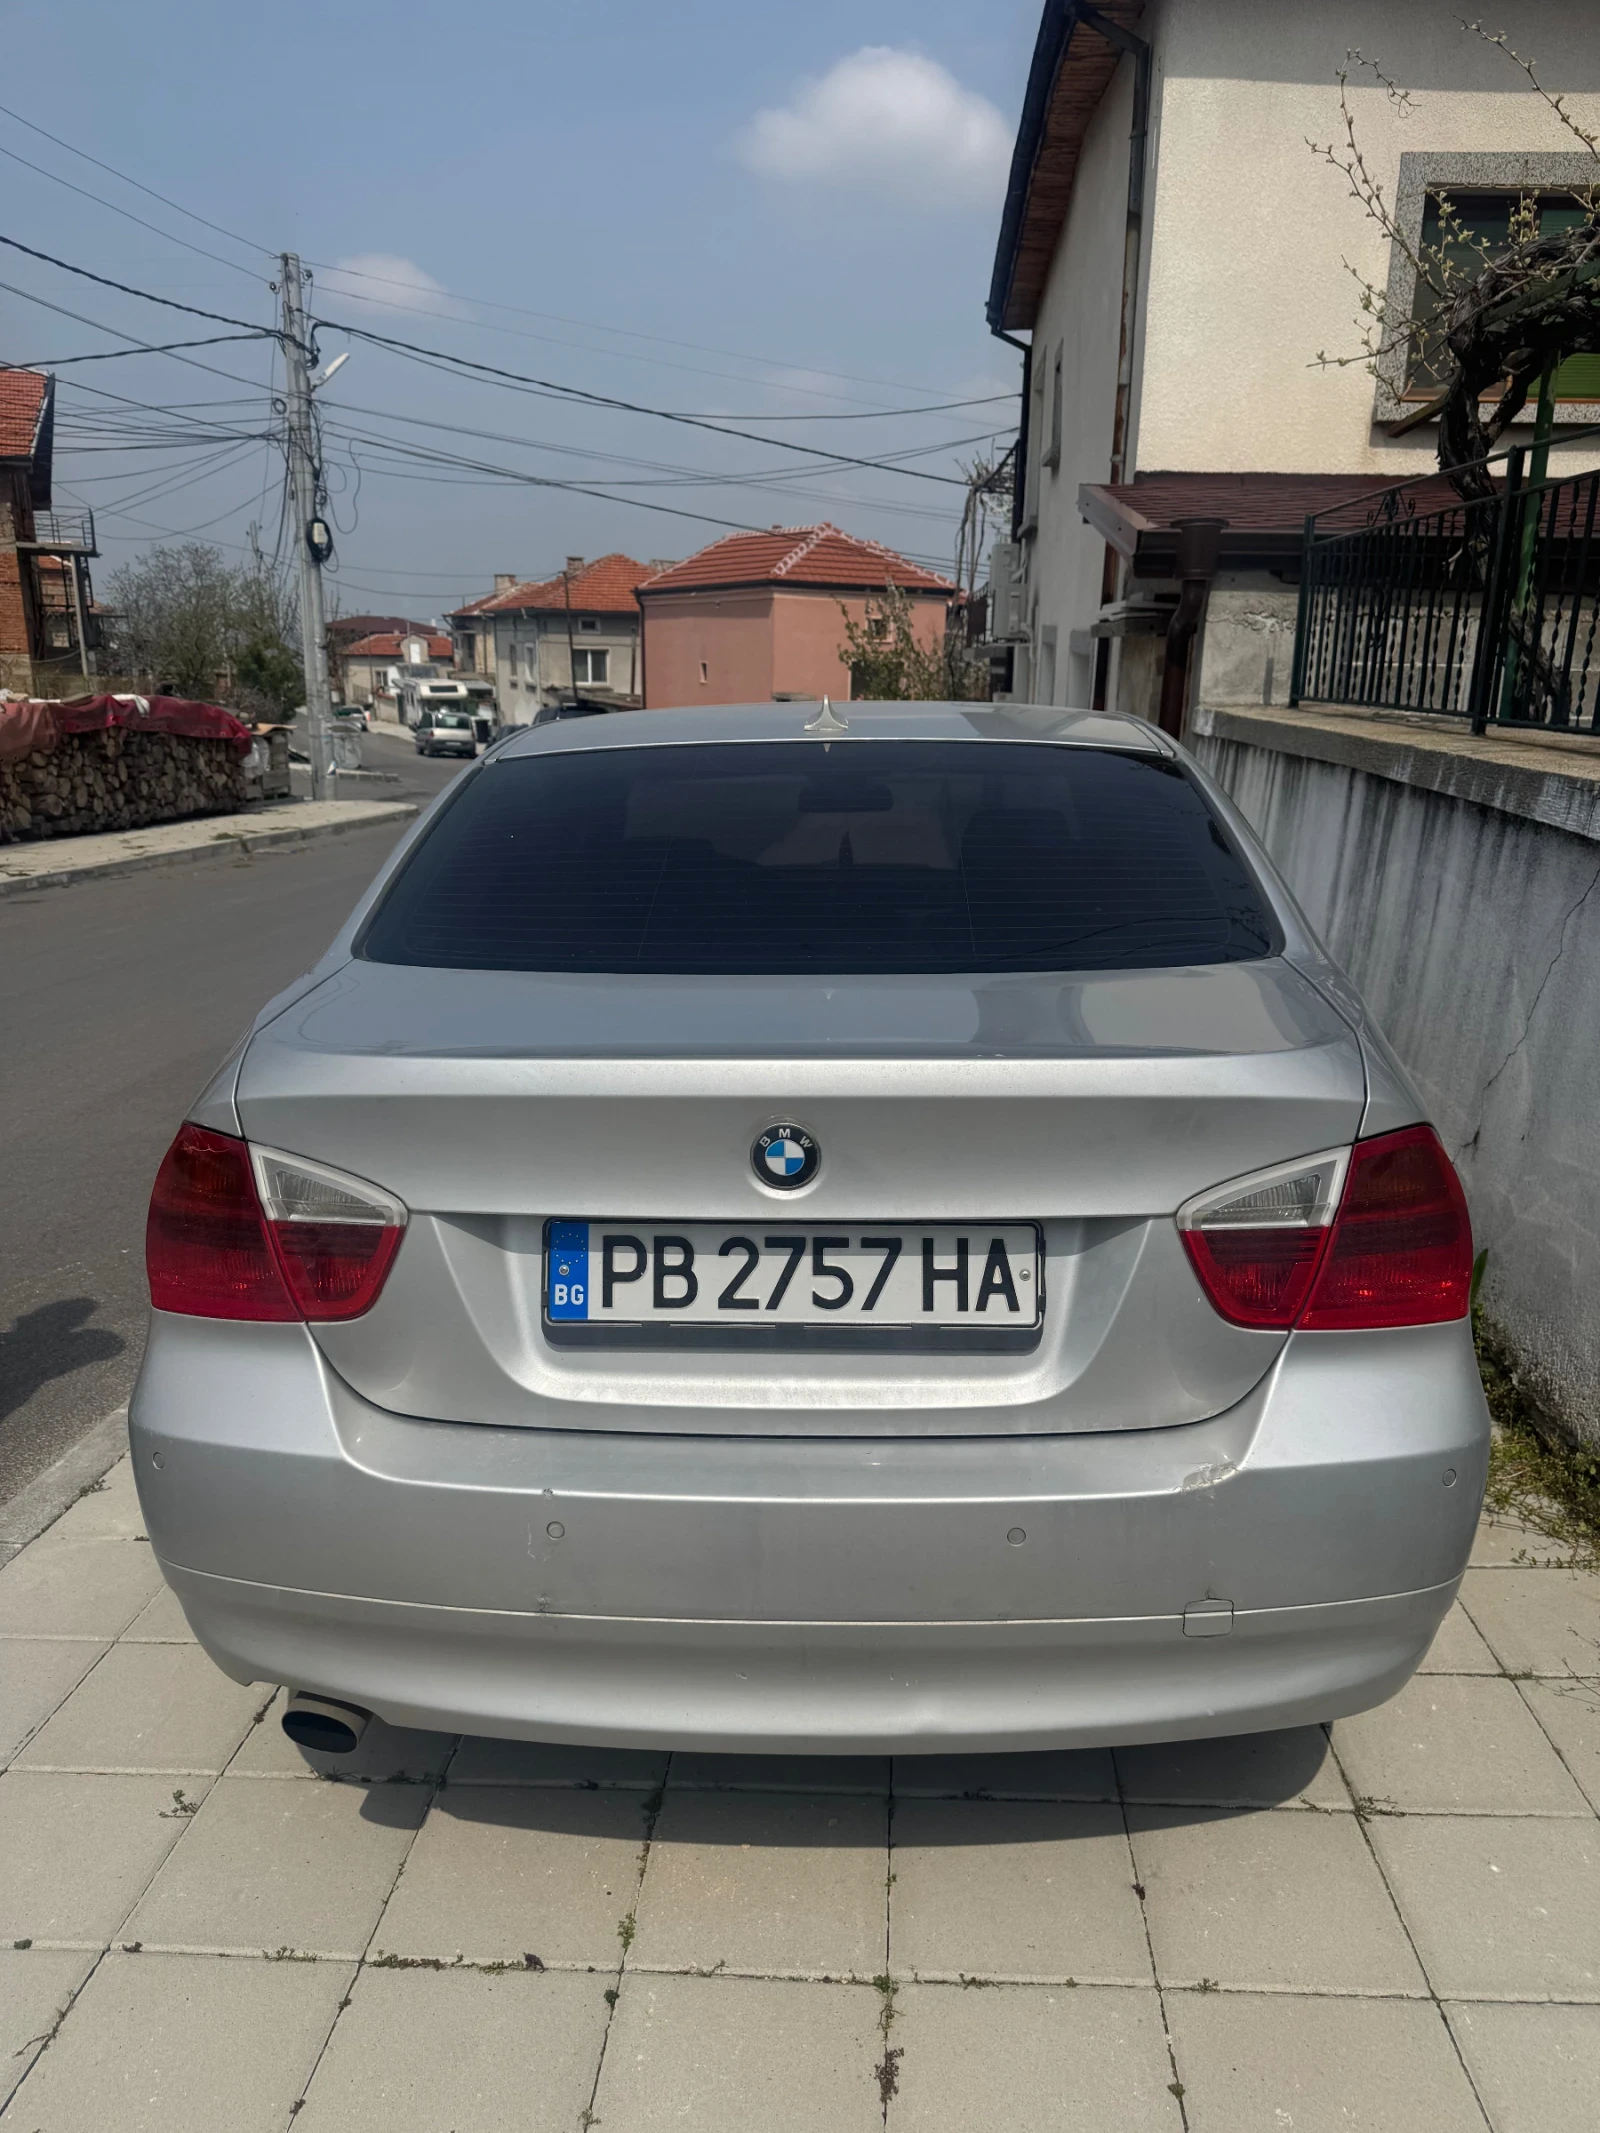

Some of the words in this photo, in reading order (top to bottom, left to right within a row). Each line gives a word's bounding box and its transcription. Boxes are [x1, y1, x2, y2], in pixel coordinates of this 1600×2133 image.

[759, 1128, 813, 1148] BMW
[602, 1234, 698, 1309] PB
[717, 1236, 903, 1311] 2757
[921, 1237, 1020, 1312] HA
[554, 1283, 584, 1306] BG
